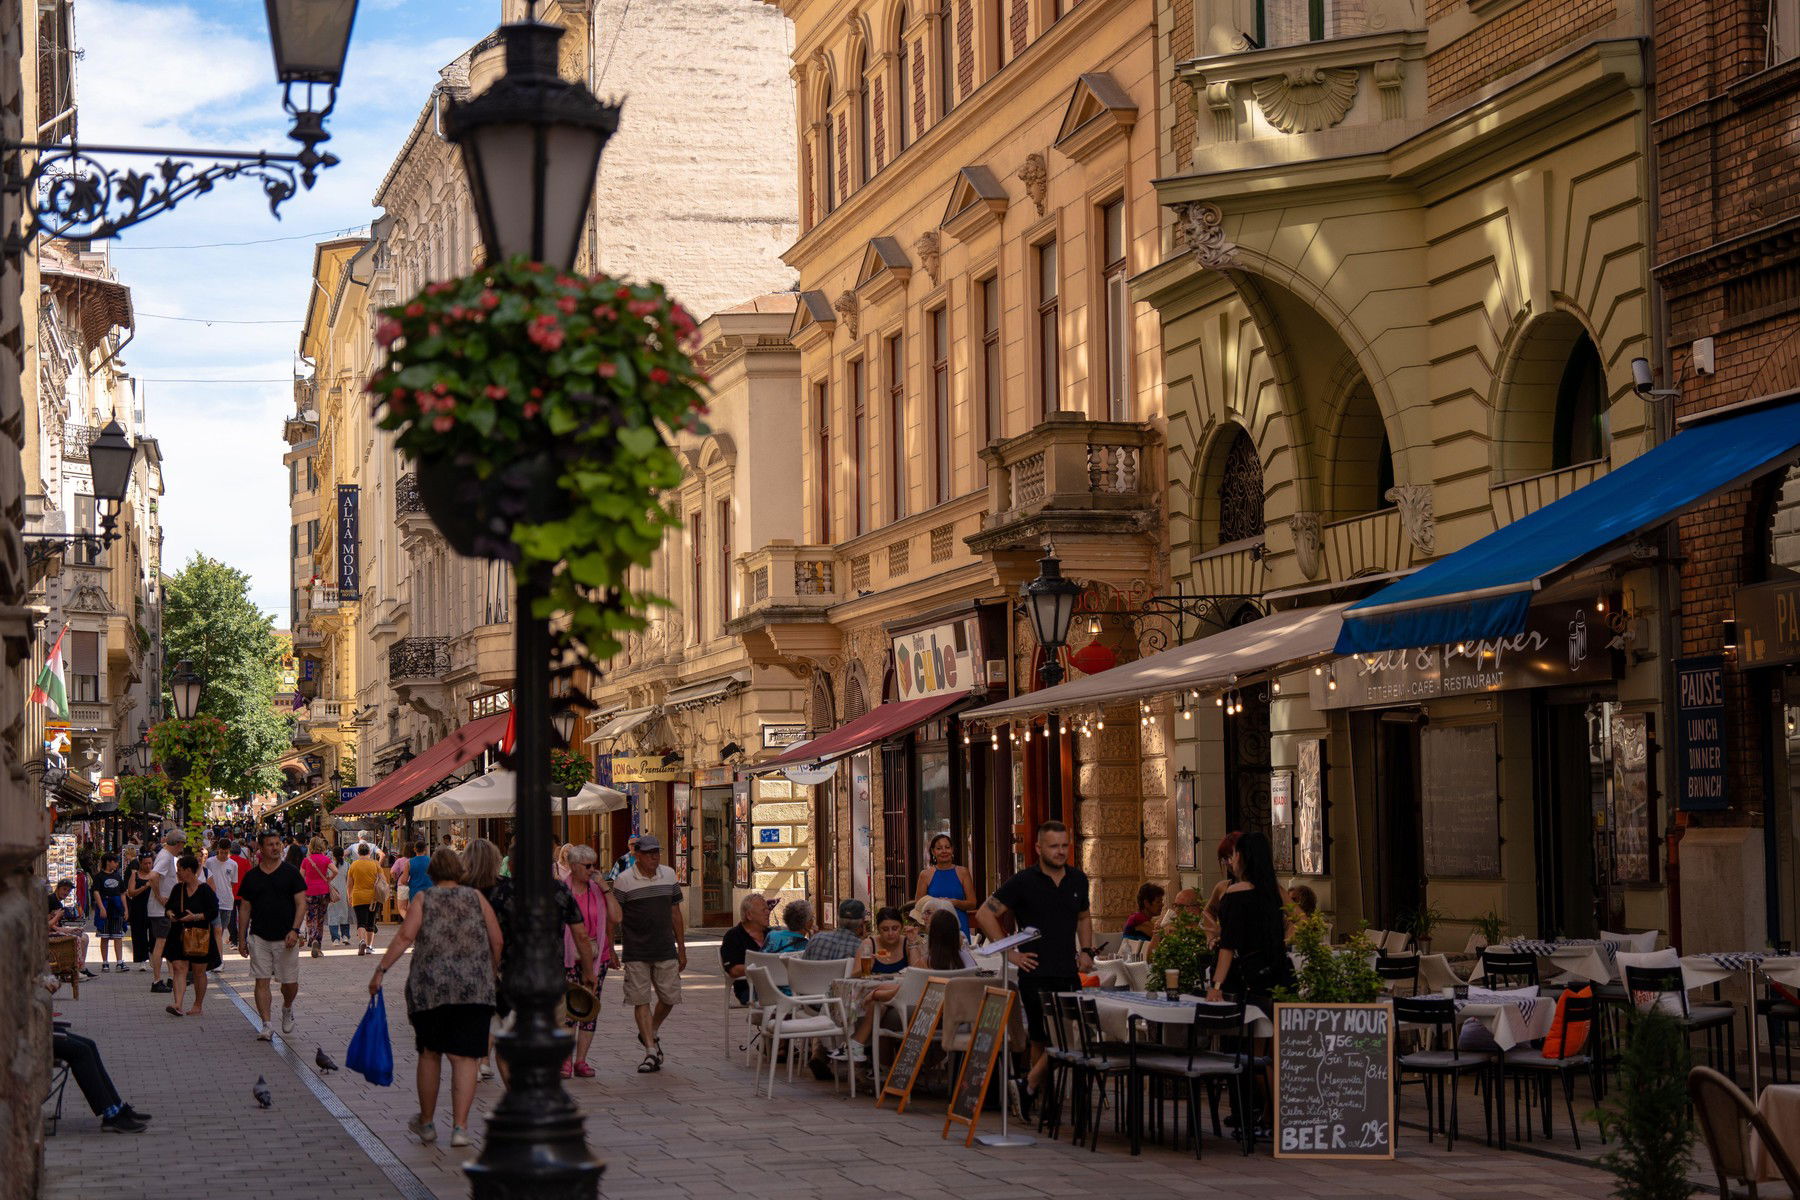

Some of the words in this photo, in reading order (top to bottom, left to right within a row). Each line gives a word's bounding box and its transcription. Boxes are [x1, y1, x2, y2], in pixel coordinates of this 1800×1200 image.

[343, 496, 354, 539] ALTA
[342, 543, 355, 587] MODA
[914, 633, 958, 694] cube
[1443, 671, 1504, 691] RESTAURANT
[1681, 671, 1722, 706] PAUSE
[1688, 718, 1718, 742] LUNCH
[1689, 747, 1721, 770] DINNER
[1688, 775, 1722, 798] BRUNCH
[1281, 1008, 1342, 1032] HAPPY
[1344, 1009, 1388, 1034] HOUR
[1324, 1052, 1344, 1066] Gin
[1282, 1124, 1347, 1151] BEER
